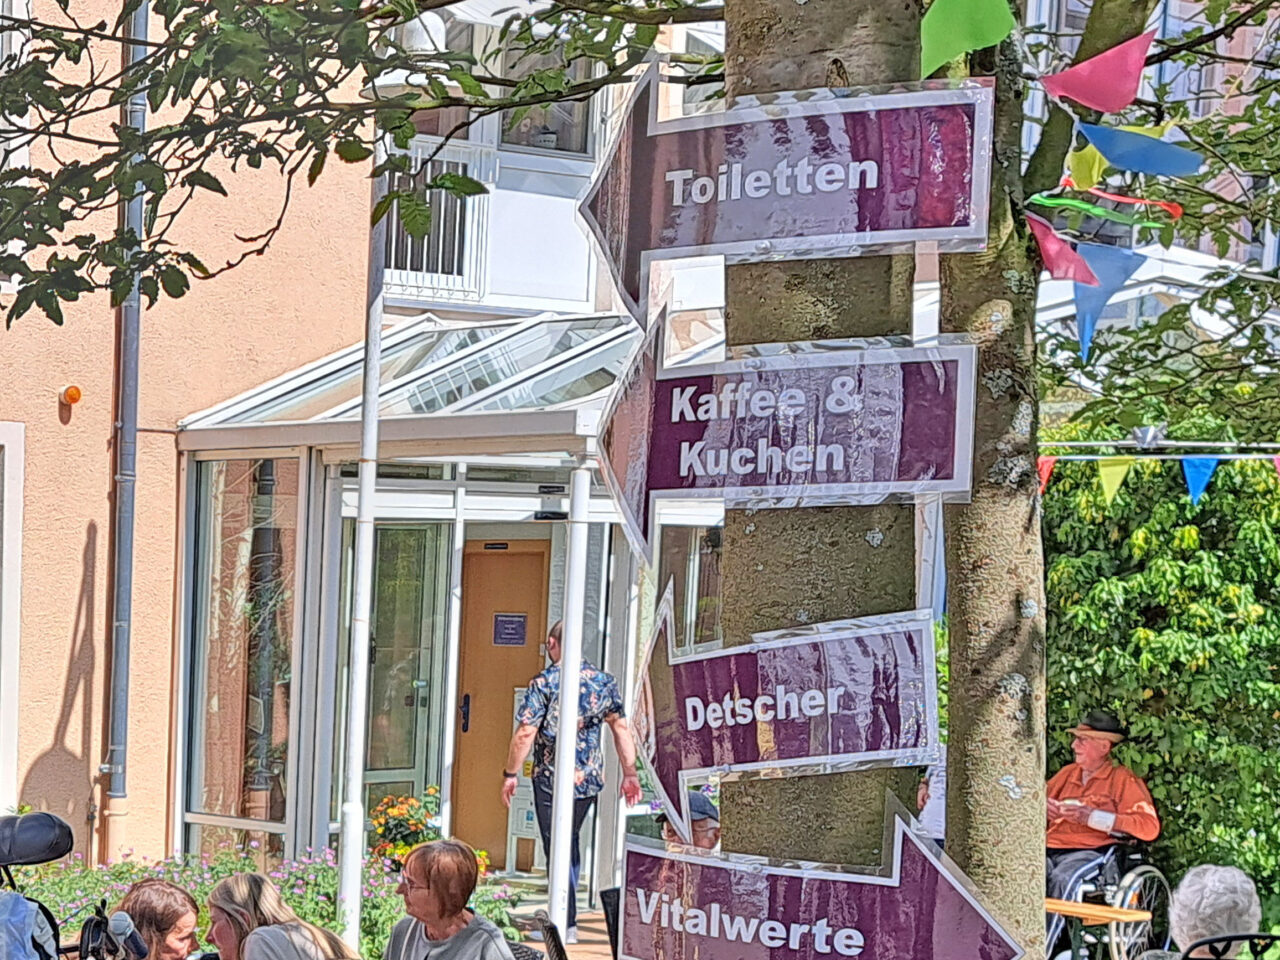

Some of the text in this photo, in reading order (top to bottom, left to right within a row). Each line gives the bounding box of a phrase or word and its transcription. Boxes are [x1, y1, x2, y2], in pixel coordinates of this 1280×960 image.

[665, 156, 879, 206] Toiletten
[671, 375, 863, 423] Kaffee &
[678, 438, 845, 477] Kuchen
[685, 684, 847, 732] Detscher
[635, 887, 865, 957] Vitalwerte
